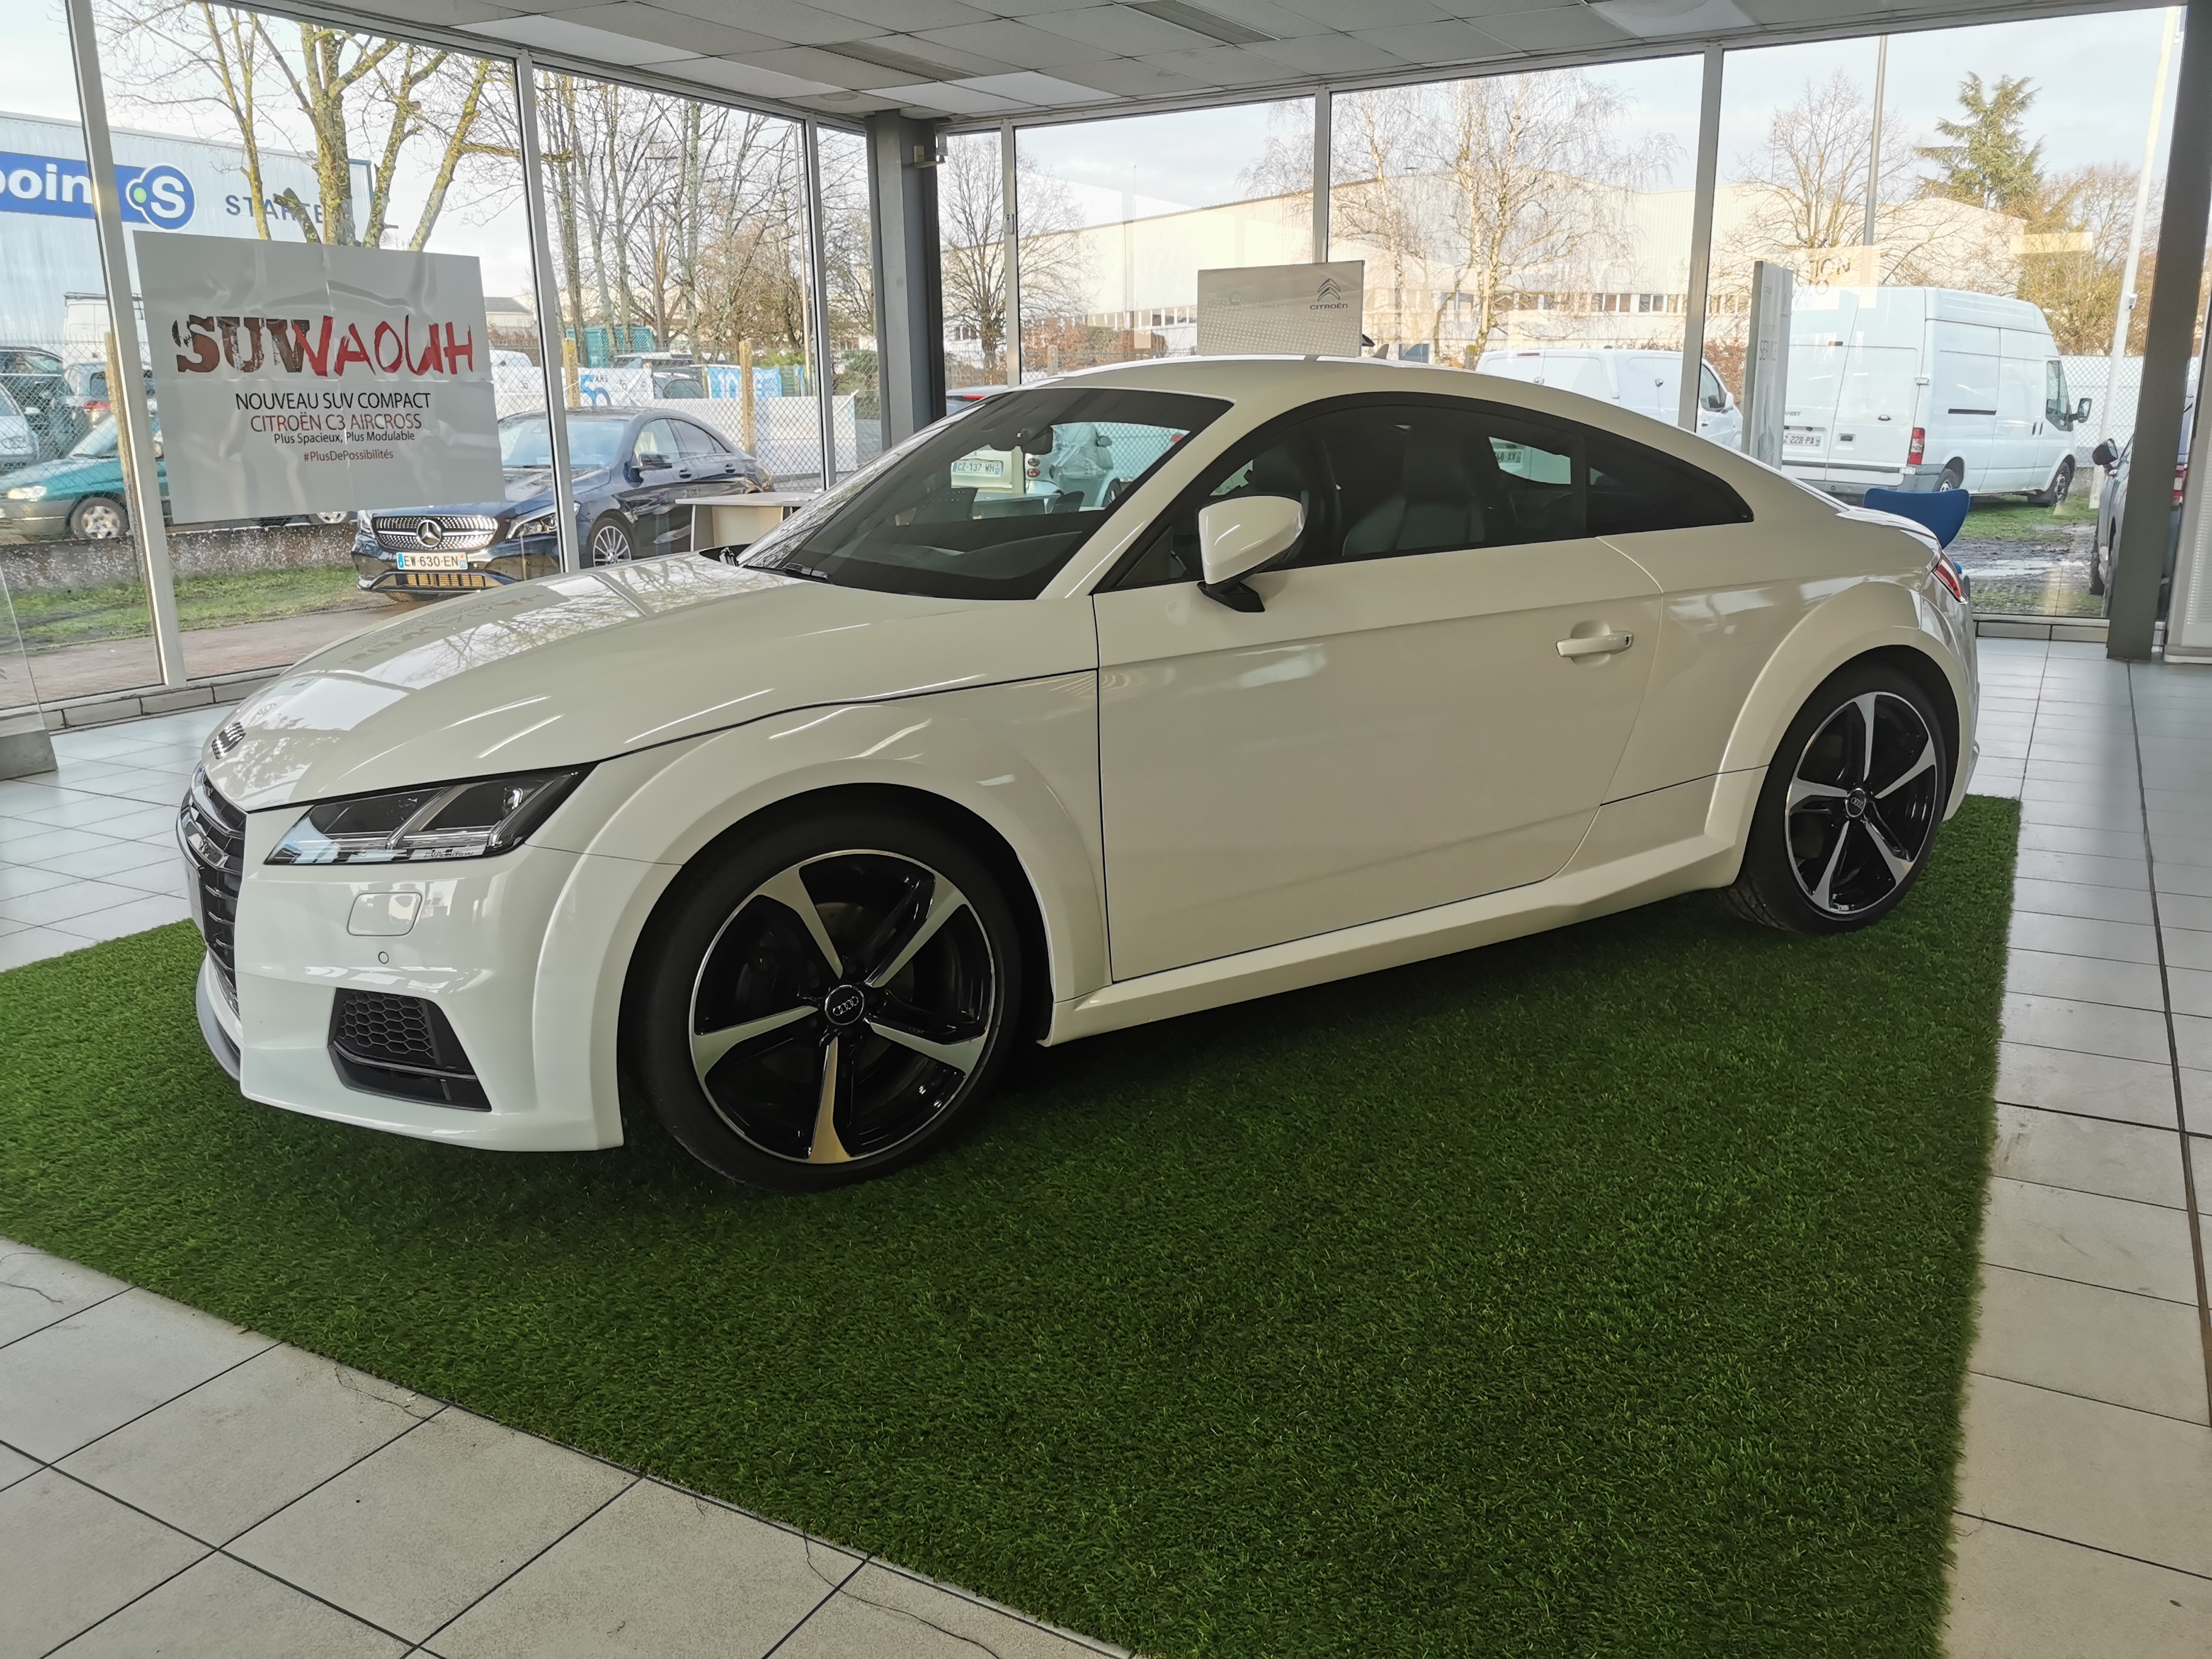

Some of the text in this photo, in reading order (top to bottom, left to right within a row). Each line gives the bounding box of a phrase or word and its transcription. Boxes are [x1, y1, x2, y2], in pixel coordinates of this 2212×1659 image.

[0, 163, 93, 204] oin
[236, 392, 431, 409] NOUVEAU SUV COMPACT
[250, 412, 422, 432] CITROËN C3 AIRCROSS
[274, 431, 415, 446] Plus Spacieux, Plus Modulable
[1783, 435, 1814, 444] Z-228-PA
[304, 449, 394, 462] #PlusDePossibilités
[404, 555, 458, 567] EW-630-EN
